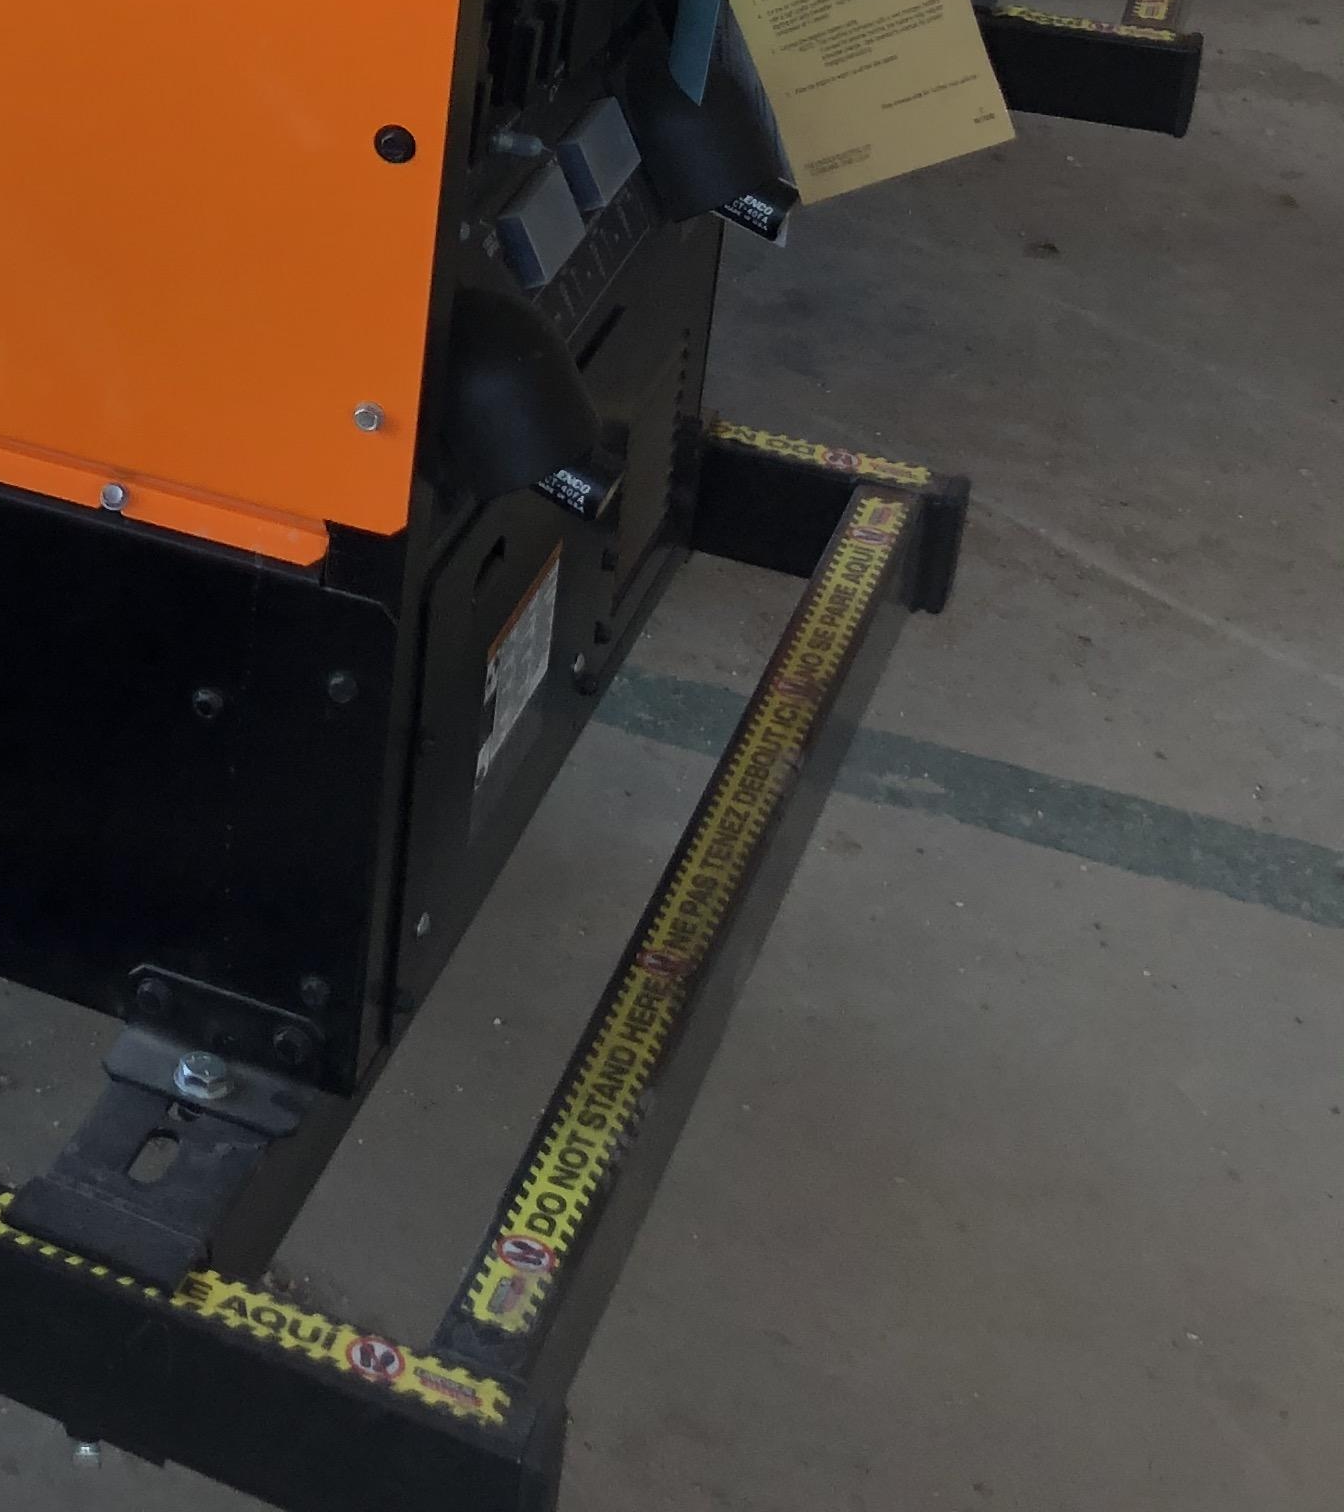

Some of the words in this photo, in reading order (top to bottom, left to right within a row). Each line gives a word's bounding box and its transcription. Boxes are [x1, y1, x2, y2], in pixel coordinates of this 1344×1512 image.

[807, 626, 836, 652] SE
[819, 583, 857, 628] PARE
[700, 807, 752, 871] TENEZ
[734, 726, 783, 808] DEBOUT
[525, 1190, 568, 1237] DO
[548, 1130, 599, 1189] NOT
[577, 1044, 637, 1131] STAND
[619, 978, 667, 1045] HERE
